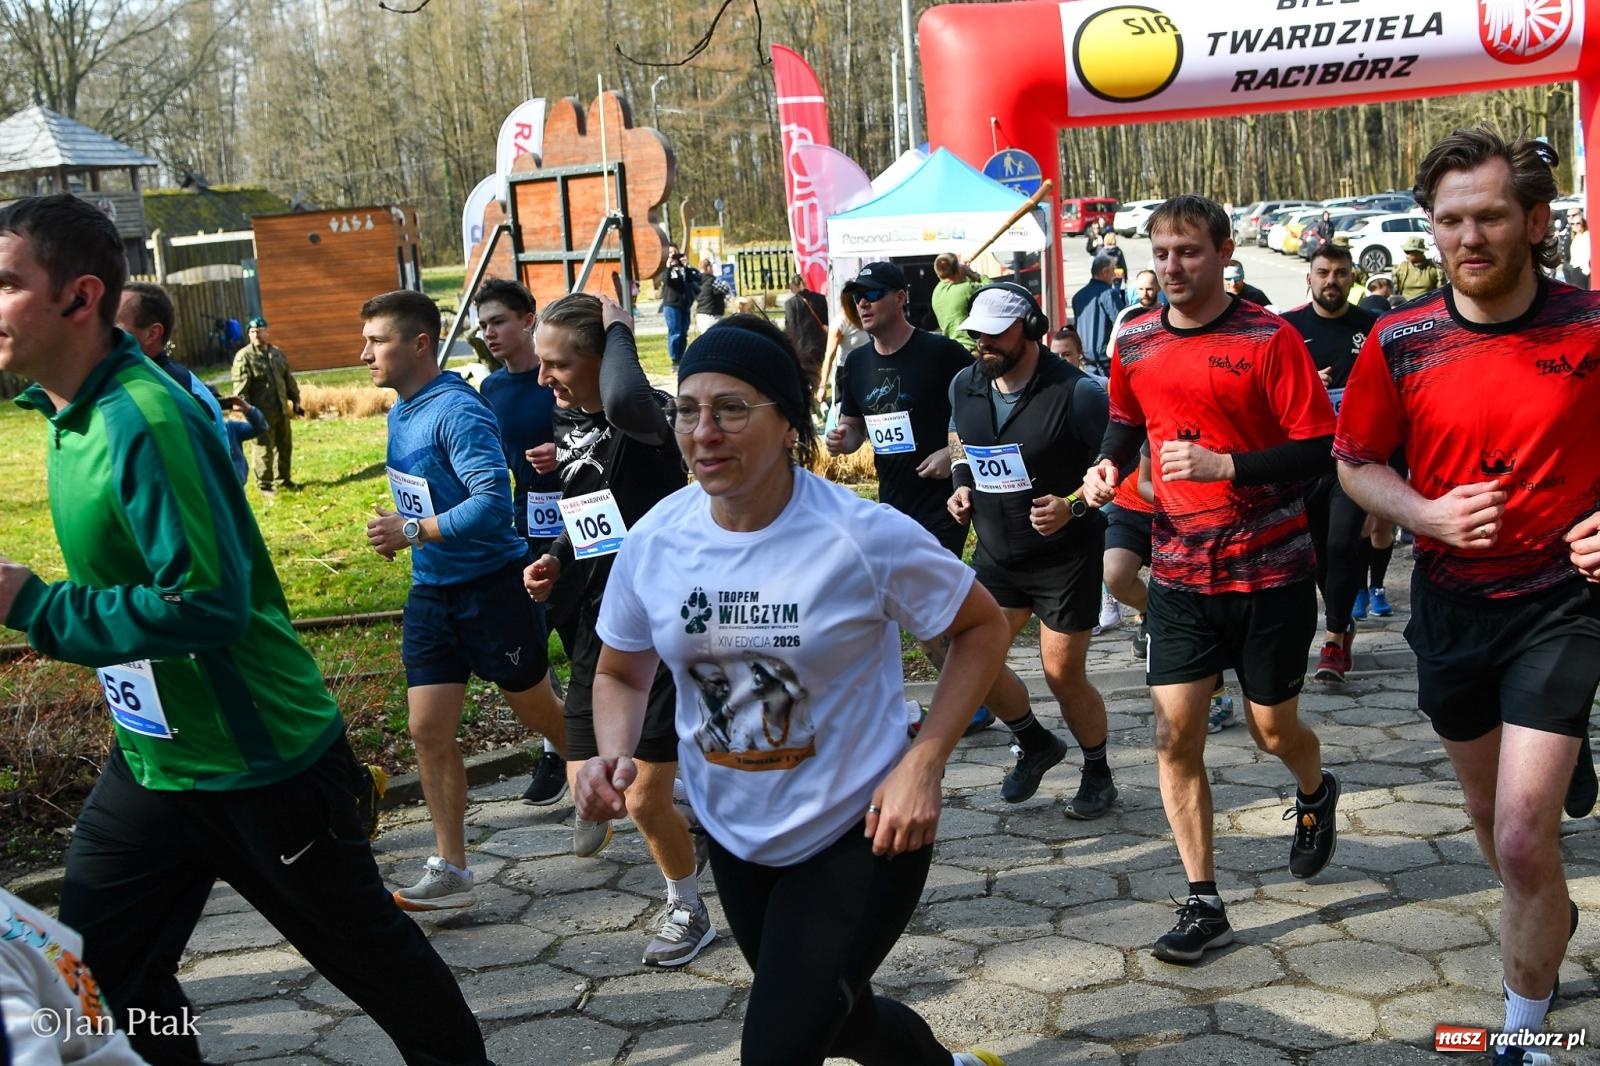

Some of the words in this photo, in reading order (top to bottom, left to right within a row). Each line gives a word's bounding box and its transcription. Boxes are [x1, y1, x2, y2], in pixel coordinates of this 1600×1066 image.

[1207, 11, 1443, 56] TWARDZIELA
[1230, 52, 1419, 92] RACIBÓRZ
[1124, 322, 1153, 336] COLO
[1392, 320, 1434, 340] COLO
[875, 427, 904, 443] 045
[976, 459, 1012, 477] 102
[397, 489, 423, 514] 105
[575, 513, 611, 540] 106
[718, 591, 760, 603] TROPEM
[718, 603, 799, 625] WILCZYM
[718, 635, 734, 648] XIV
[735, 635, 772, 648] EDYCJA
[773, 635, 801, 648] 2026
[103, 673, 141, 711] 56
